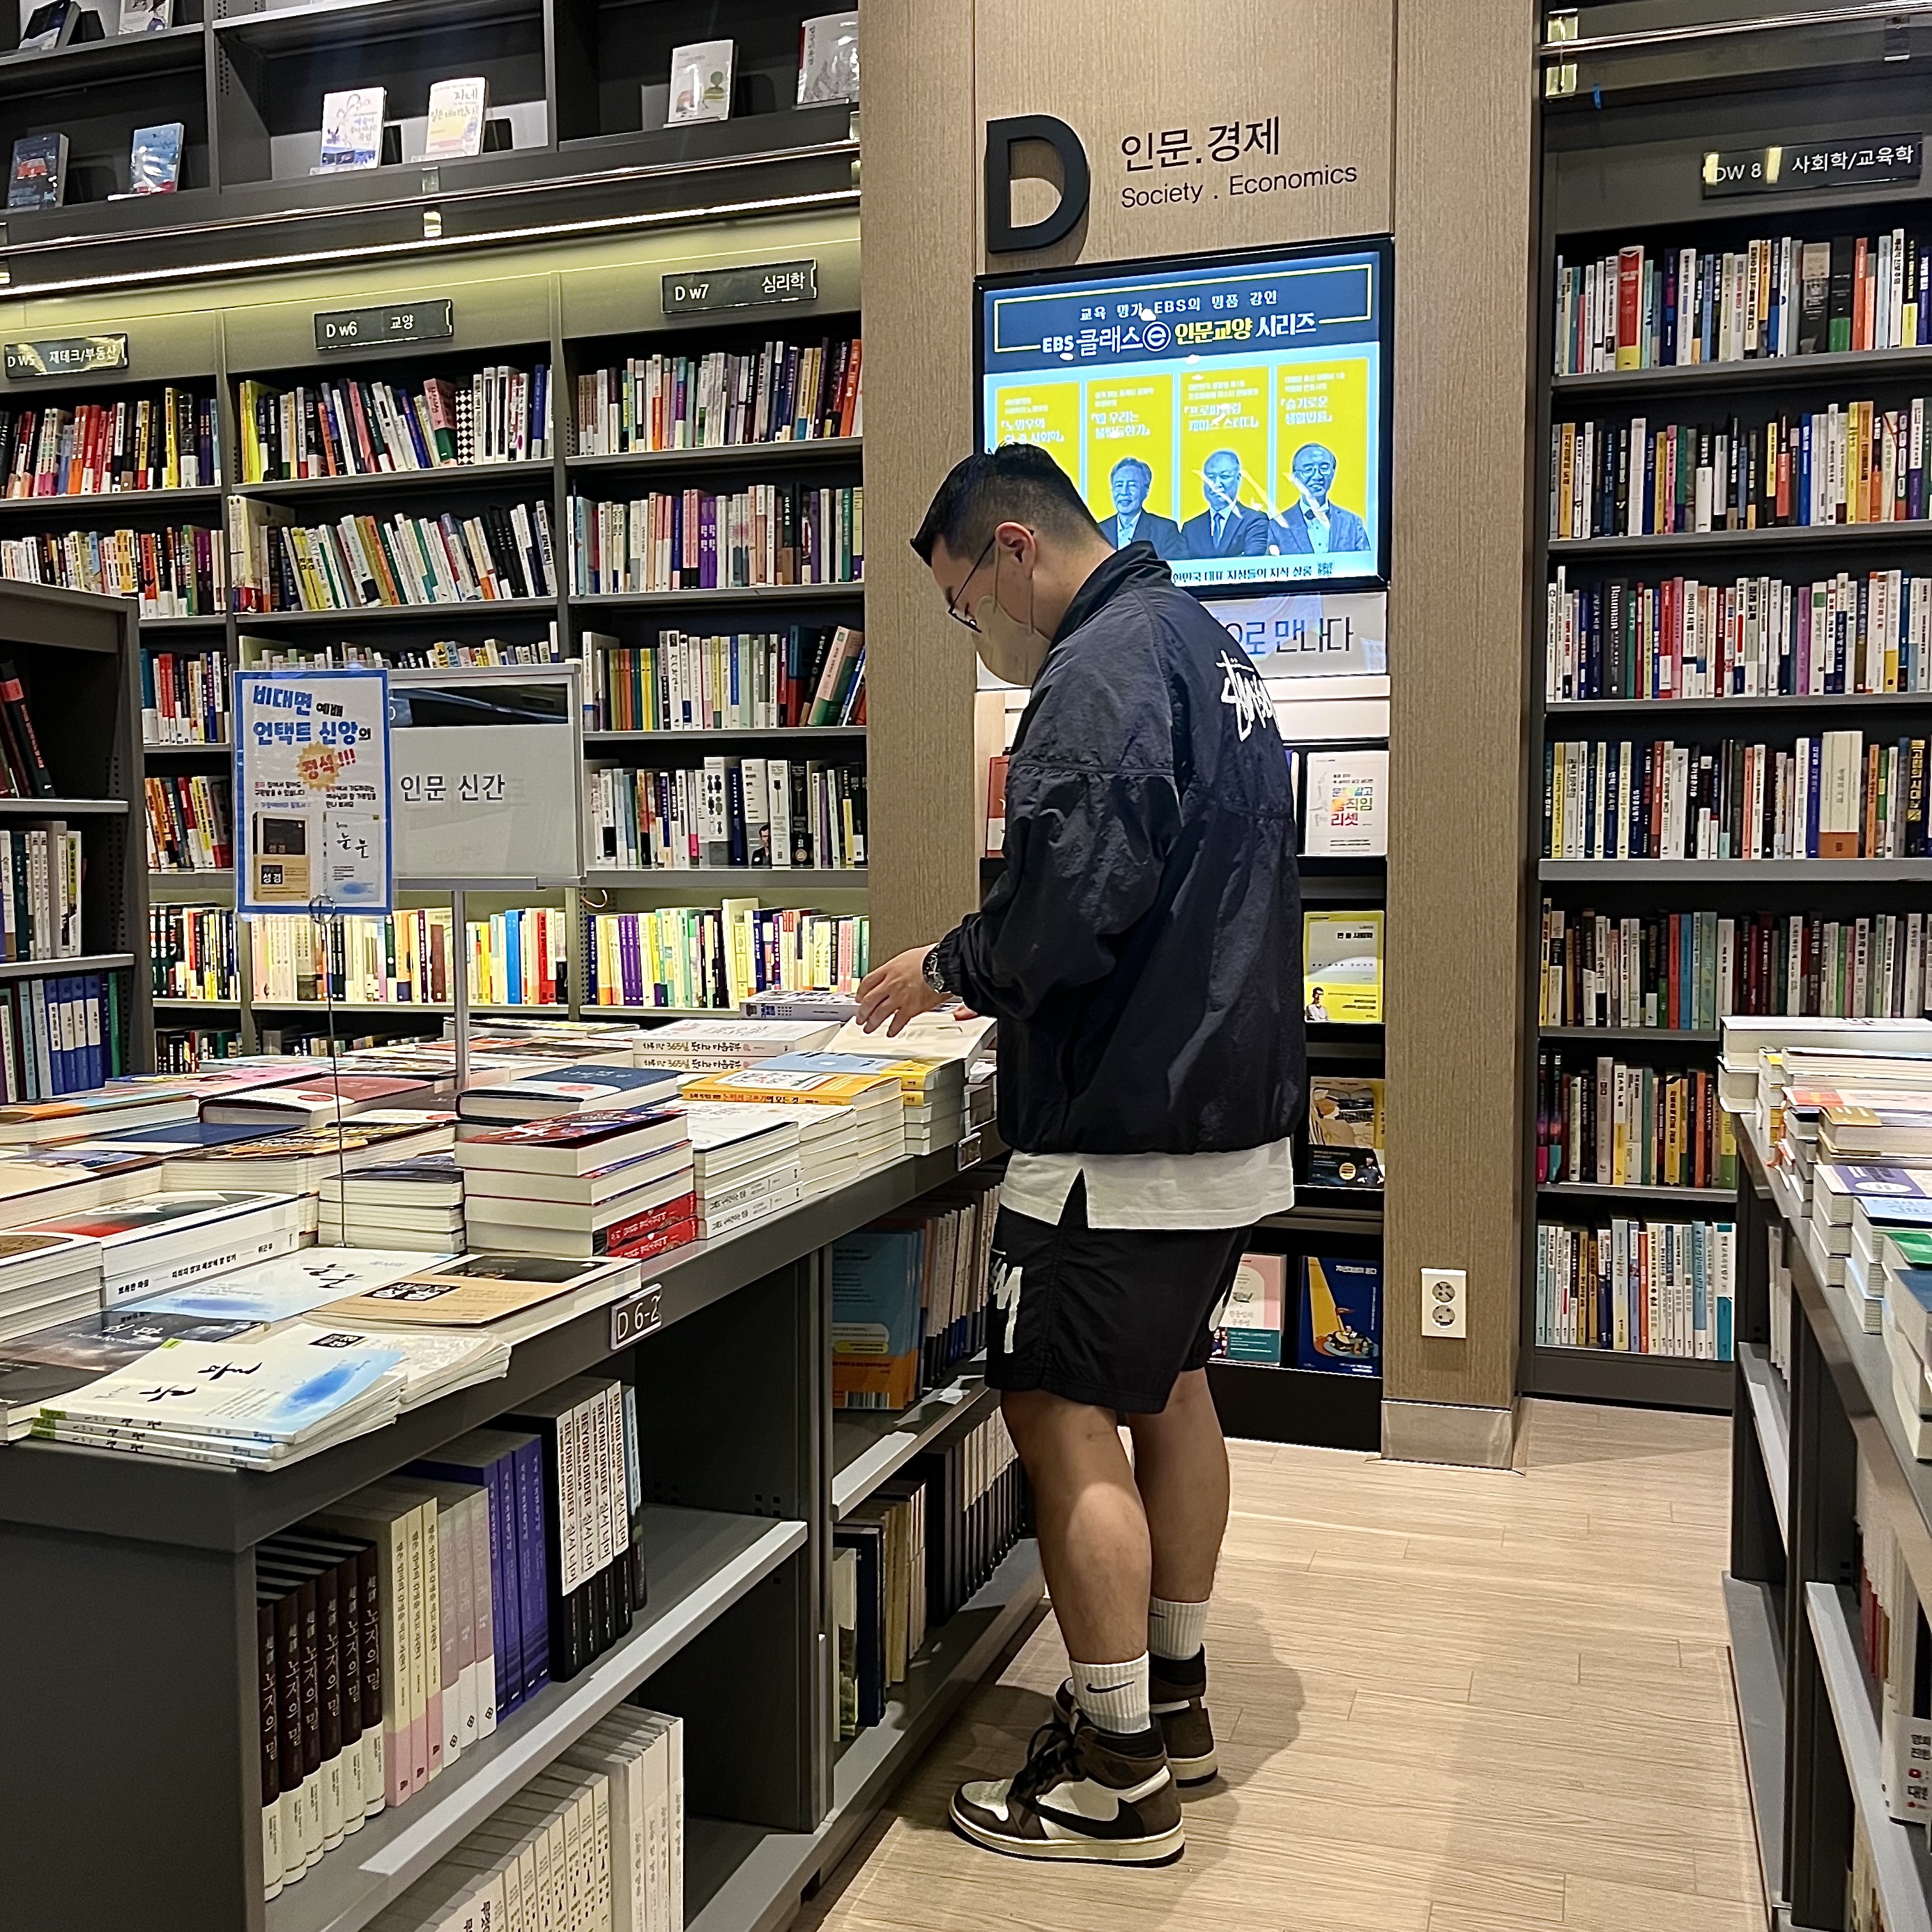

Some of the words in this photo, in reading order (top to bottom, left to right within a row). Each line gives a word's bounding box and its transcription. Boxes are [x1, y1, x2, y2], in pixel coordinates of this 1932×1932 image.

[1121, 116, 1279, 172] 인문.경제
[1751, 162, 1762, 178] 8
[1792, 144, 1914, 174] 사회학/교육학
[986, 114, 1090, 254] D
[1121, 181, 1203, 208] Society
[1230, 165, 1358, 195] Economics
[675, 286, 686, 301] D
[762, 272, 805, 293] 심리학
[325, 322, 336, 338] D
[390, 314, 414, 332] 교양
[1080, 306, 1107, 321] 교육
[1154, 297, 1201, 314] EBS의
[1211, 293, 1239, 309] 명품
[1042, 334, 1074, 353] EBS
[1174, 317, 1253, 345] 인문교양
[1255, 312, 1317, 337] 시리즈
[7, 356, 16, 367] D
[1275, 616, 1354, 653] 만나다
[252, 685, 313, 716] 비대면
[316, 702, 344, 717] 예배
[252, 721, 312, 746] 언택트
[319, 721, 372, 746] 신앙의
[401, 774, 447, 802] 인문
[457, 774, 506, 801] 신간
[1331, 812, 1358, 826] 리셋
[263, 873, 281, 883] 성경
[666, 1042, 689, 1052] 365일
[713, 1042, 742, 1052] 마음공부
[668, 1059, 691, 1070] 365일
[713, 1059, 742, 1069] 마음공부
[617, 1312, 629, 1340] D
[634, 1294, 659, 1330] 6-2
[581, 1412, 590, 1462] BEYOND
[597, 1402, 606, 1452] BEYOND
[613, 1393, 622, 1443] BEYOND
[564, 1422, 574, 1473] BEYOND
[615, 1443, 624, 1483] ORDER
[583, 1464, 592, 1506] ORDER
[599, 1453, 608, 1495] ORDER
[566, 1474, 576, 1518] ORDER
